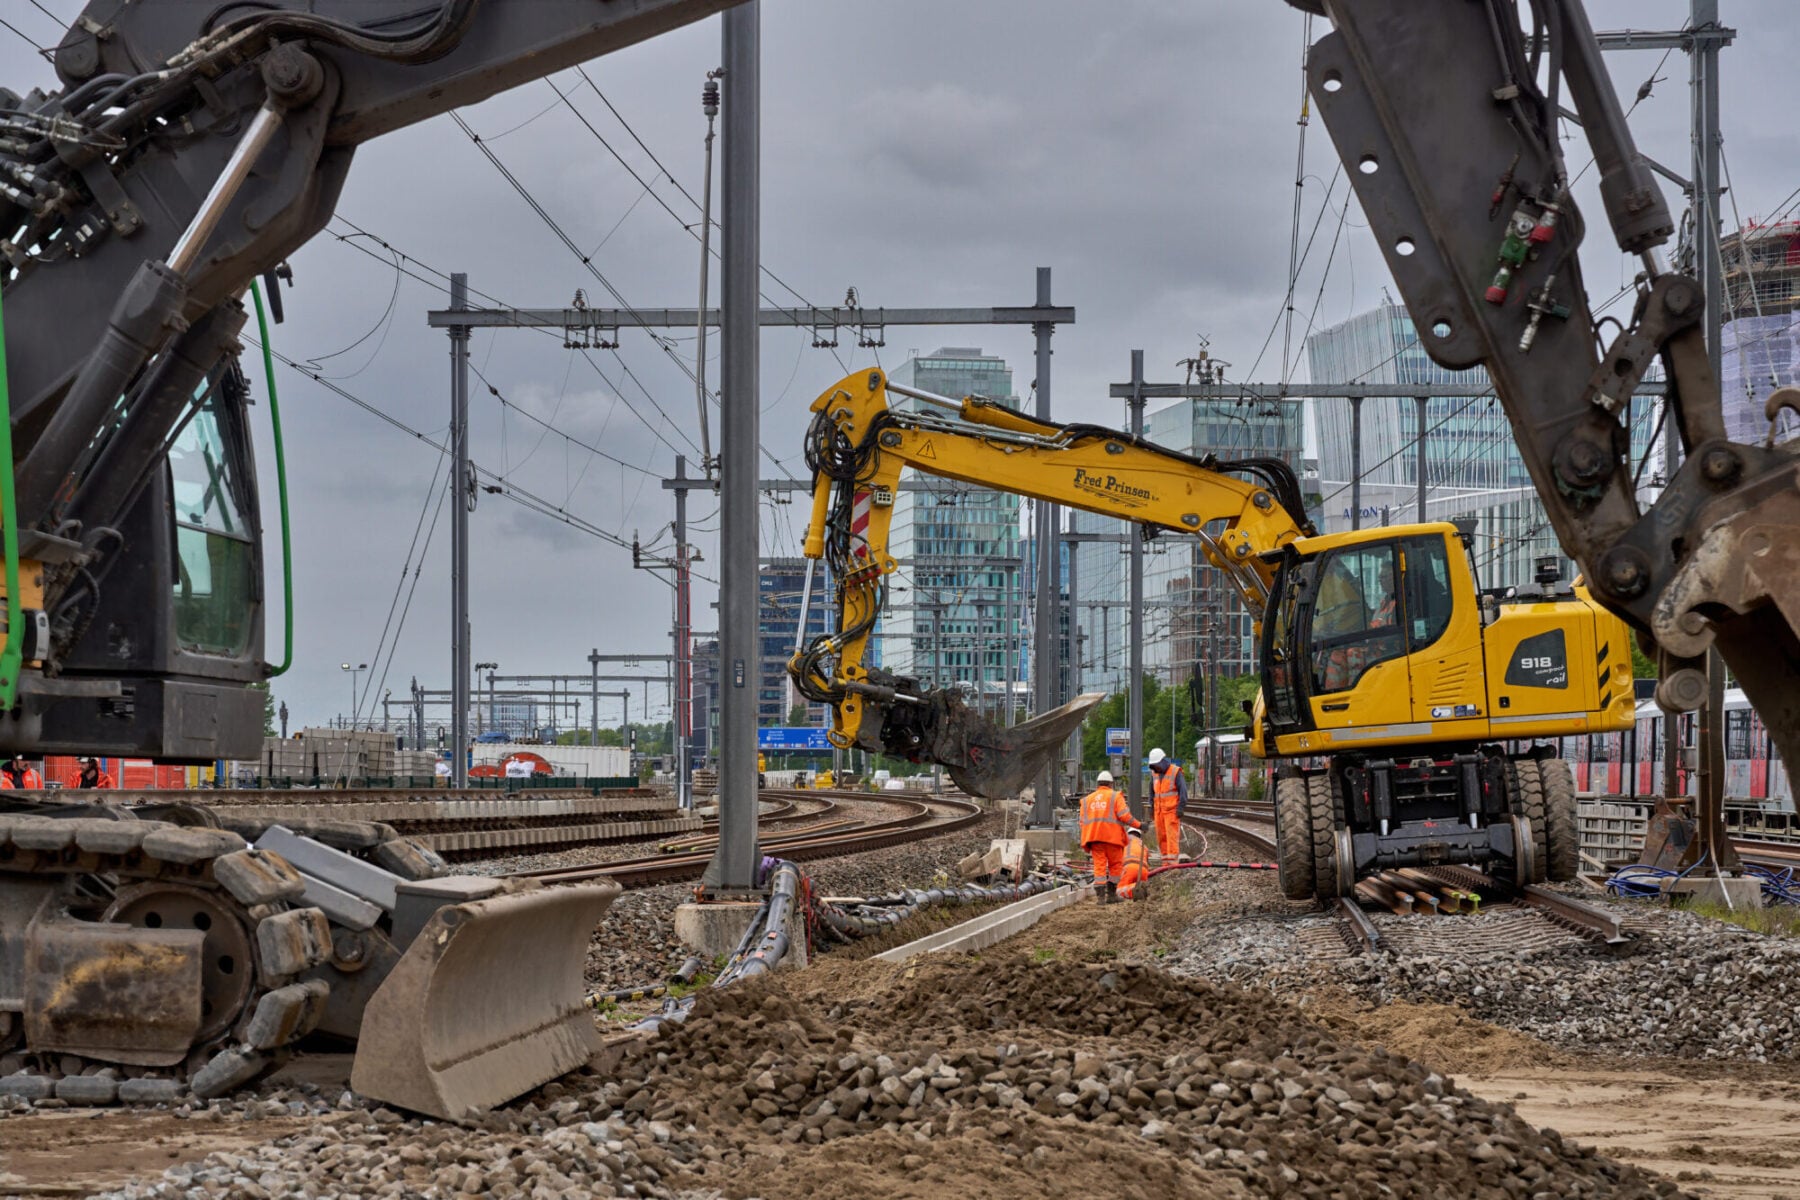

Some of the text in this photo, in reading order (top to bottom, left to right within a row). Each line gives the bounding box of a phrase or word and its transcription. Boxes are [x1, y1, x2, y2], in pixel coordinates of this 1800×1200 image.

[1074, 468, 1102, 488] Fred
[1105, 475, 1151, 499] Prinsen
[1521, 656, 1552, 669] 918
[1546, 672, 1566, 685] rail
